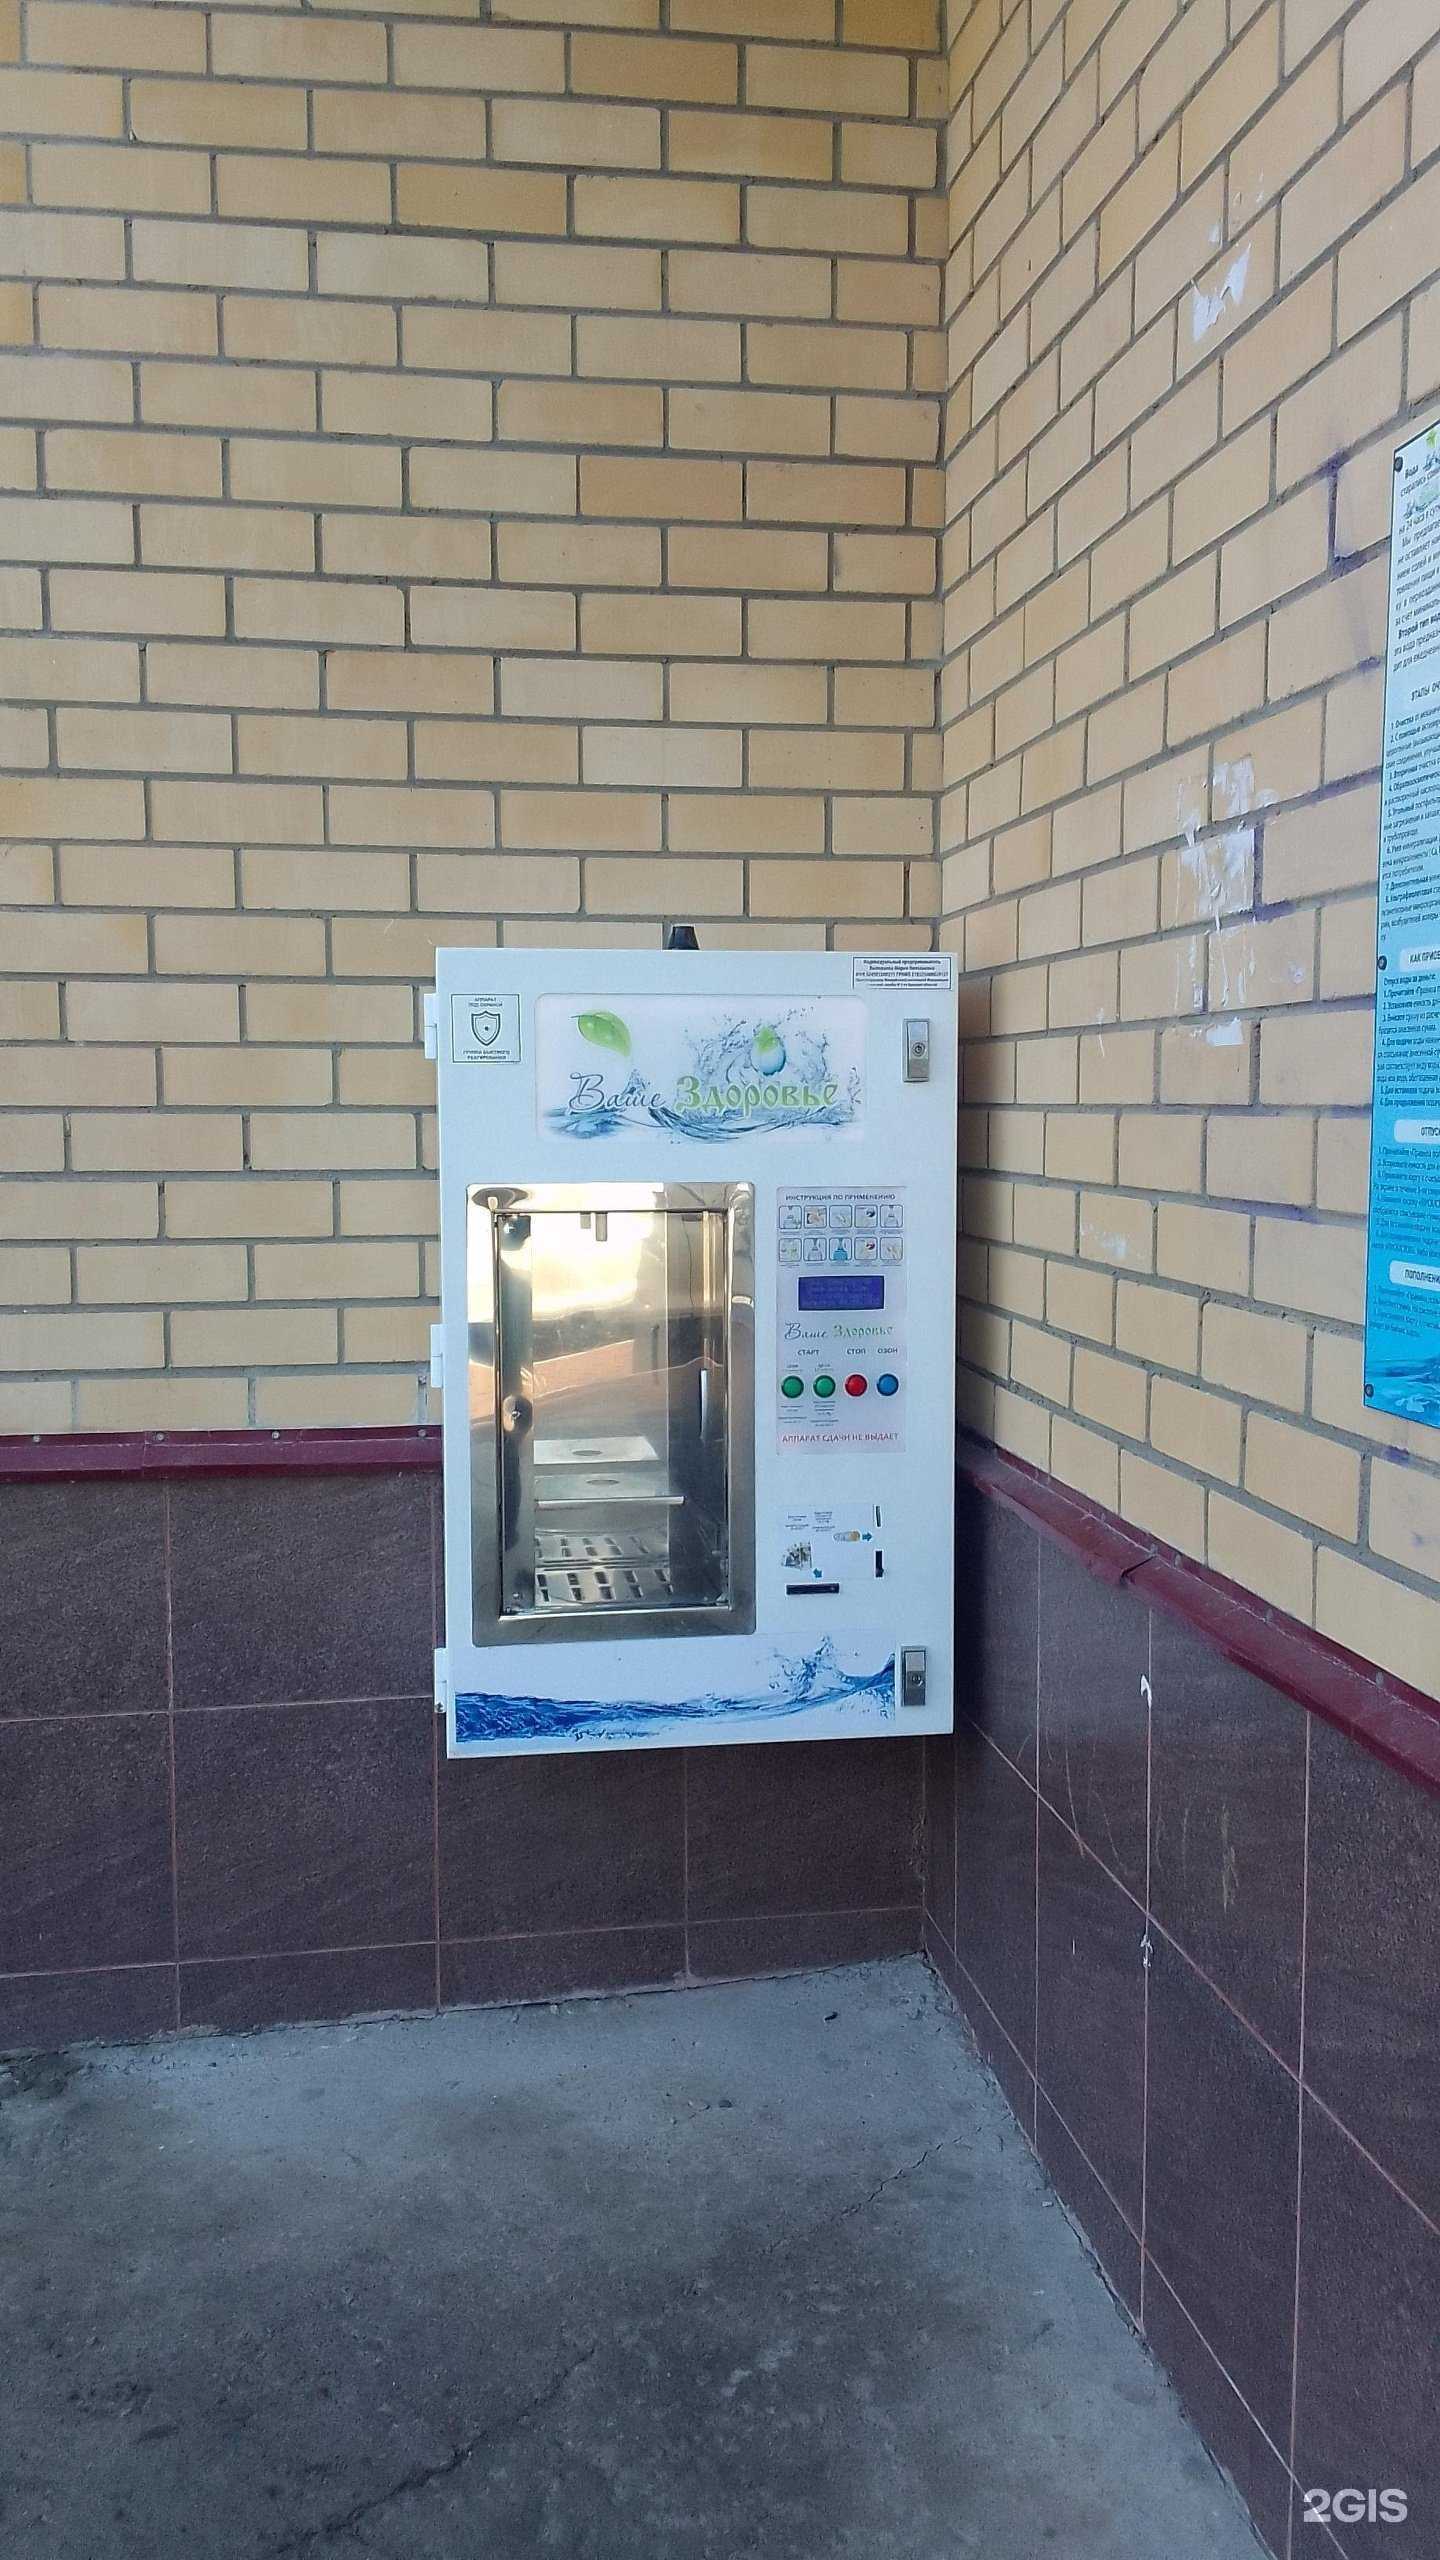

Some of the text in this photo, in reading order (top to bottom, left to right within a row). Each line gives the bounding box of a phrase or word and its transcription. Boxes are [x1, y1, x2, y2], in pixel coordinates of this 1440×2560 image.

[568, 1072, 838, 1118] Ваше Здоровье
[785, 1193, 896, 1202] ИНСТРУКЦИЯ ПО ПРИМЕНЕНИЮ
[832, 1324, 894, 1339] Здоровье
[797, 1346, 898, 1357] СТАРТ СТОП ОЗОН
[782, 1432, 898, 1443] АППАРАТ СДАЧИ НЕ ВЫДАЕТ
